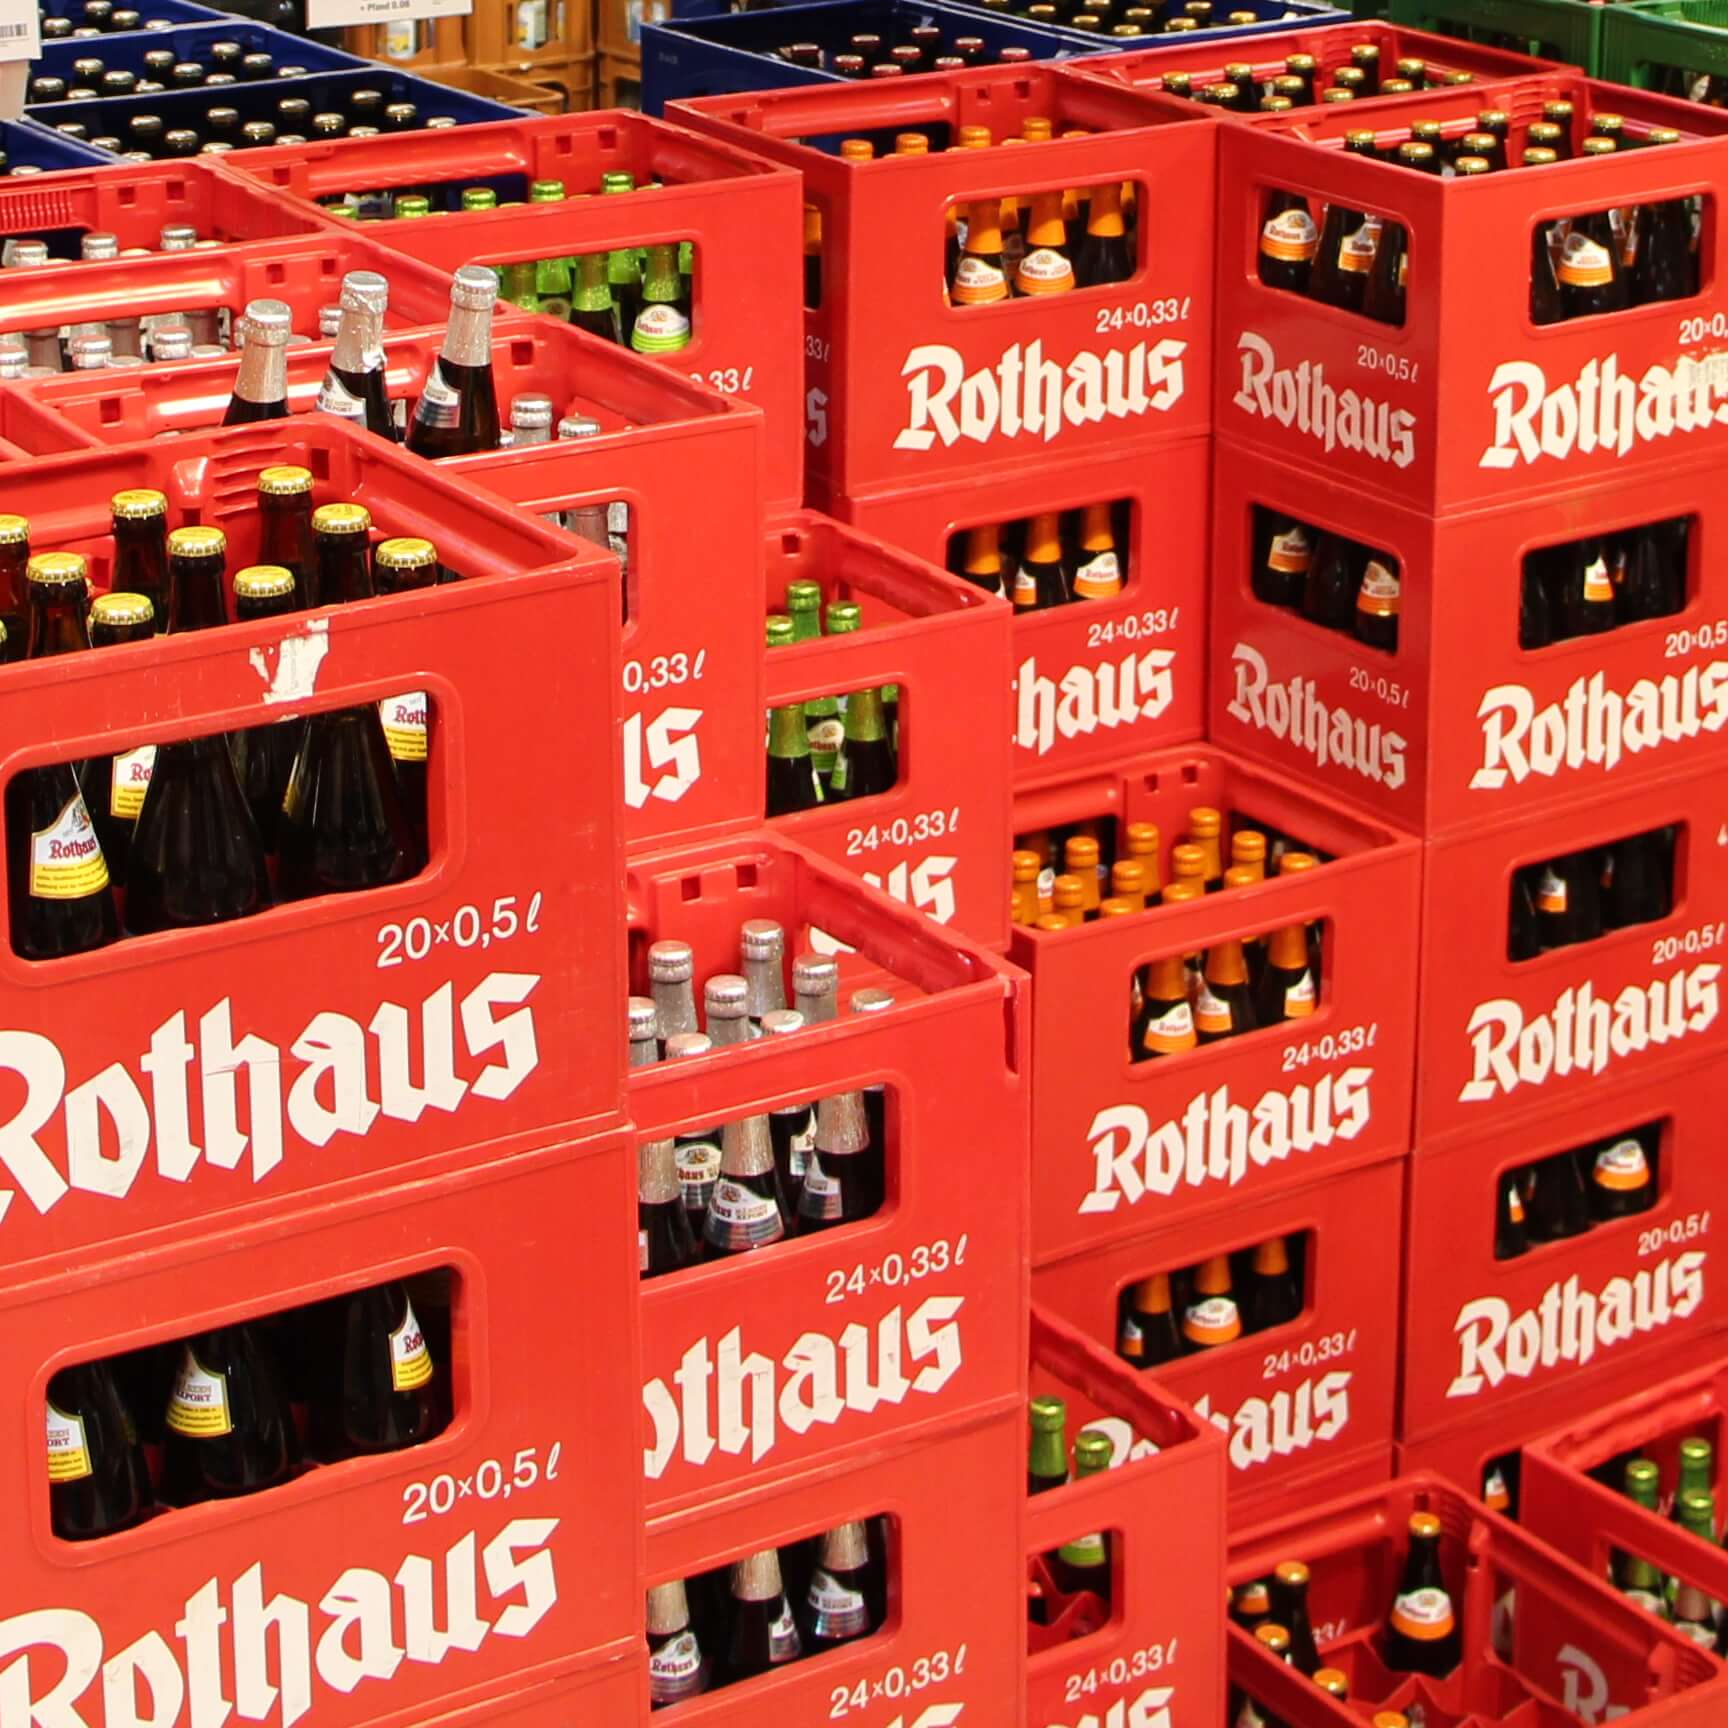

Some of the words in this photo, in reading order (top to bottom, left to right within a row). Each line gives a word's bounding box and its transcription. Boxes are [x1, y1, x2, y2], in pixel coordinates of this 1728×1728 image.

[892, 338, 1189, 452] Rothaus
[1232, 330, 1418, 470] Rothaus
[1231, 642, 1408, 792] Rothaus
[1459, 962, 1724, 1103] Rothaus
[1078, 1067, 1374, 1216] Rothaus
[1446, 1250, 1708, 1399] Rothaus
